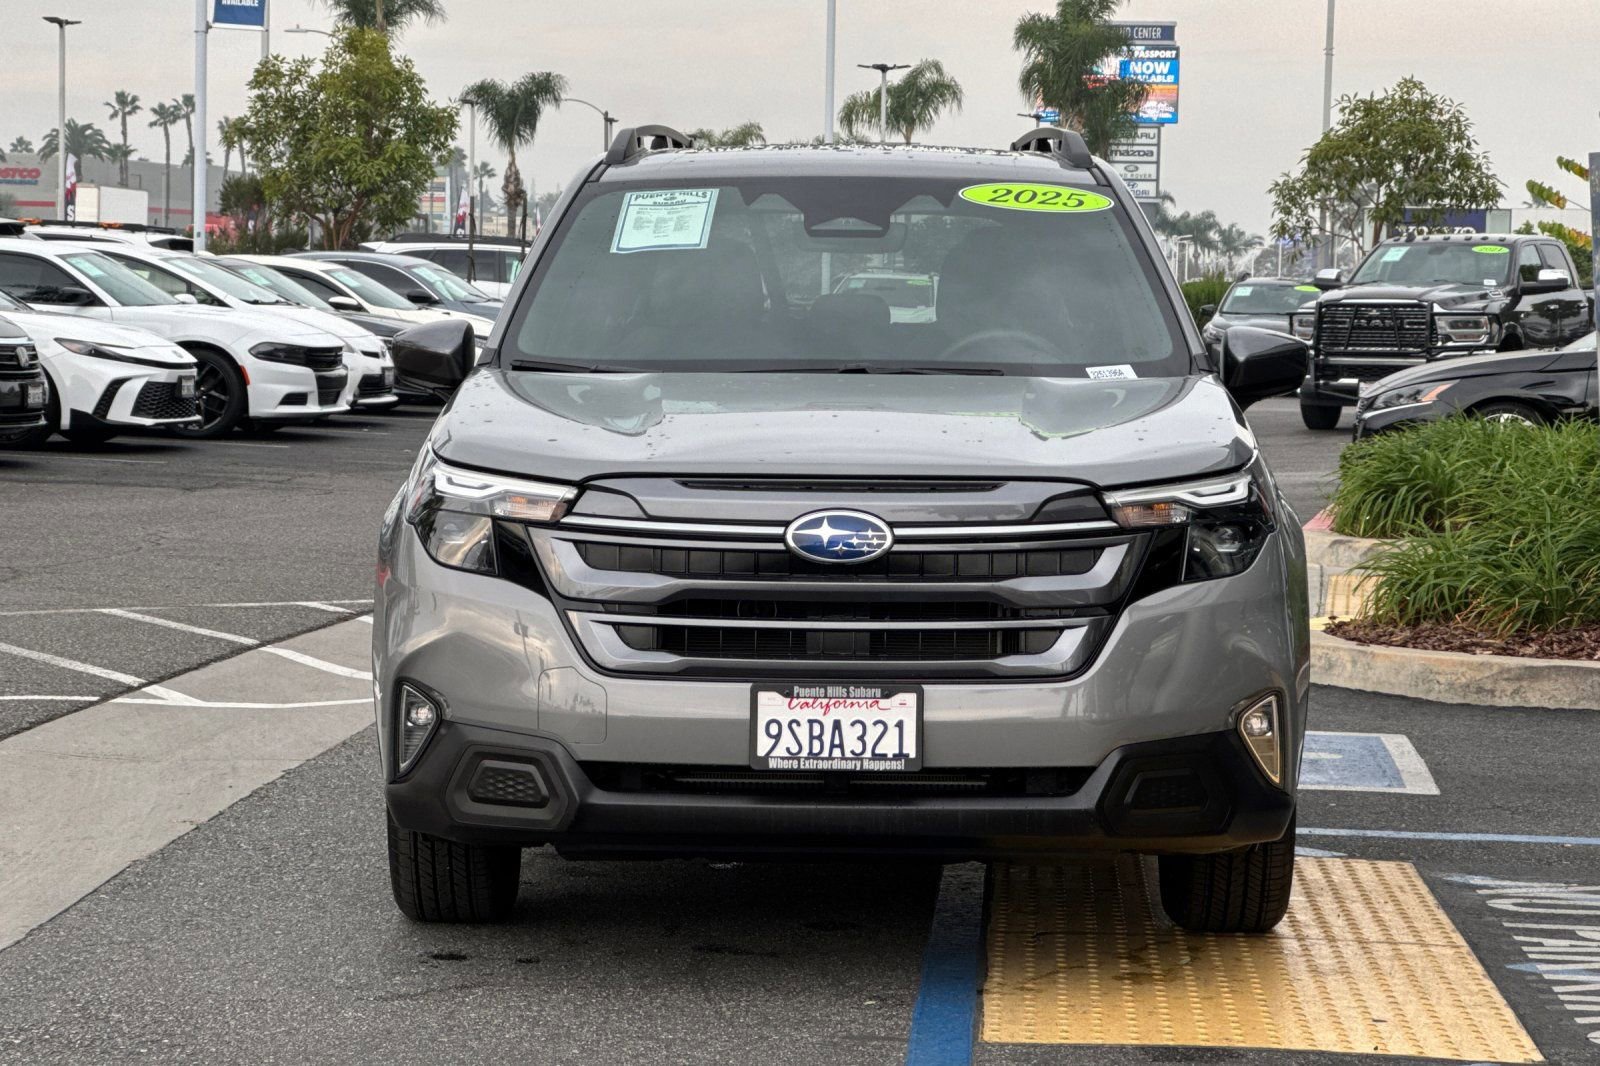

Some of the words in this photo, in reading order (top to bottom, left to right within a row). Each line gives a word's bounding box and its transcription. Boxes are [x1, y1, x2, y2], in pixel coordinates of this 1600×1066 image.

[1133, 27, 1162, 39] CENTER
[1134, 50, 1177, 58] PASSPORT
[1129, 61, 1171, 75] NOW
[987, 188, 1088, 208] 2025
[793, 685, 825, 699] Puente
[826, 686, 848, 699] Hills
[849, 686, 882, 699] Subaru
[787, 697, 891, 716] California
[764, 718, 910, 758] 9SBA321
[768, 757, 799, 770] Where
[800, 757, 862, 771] Extraordinary
[862, 758, 905, 771] Happens!
